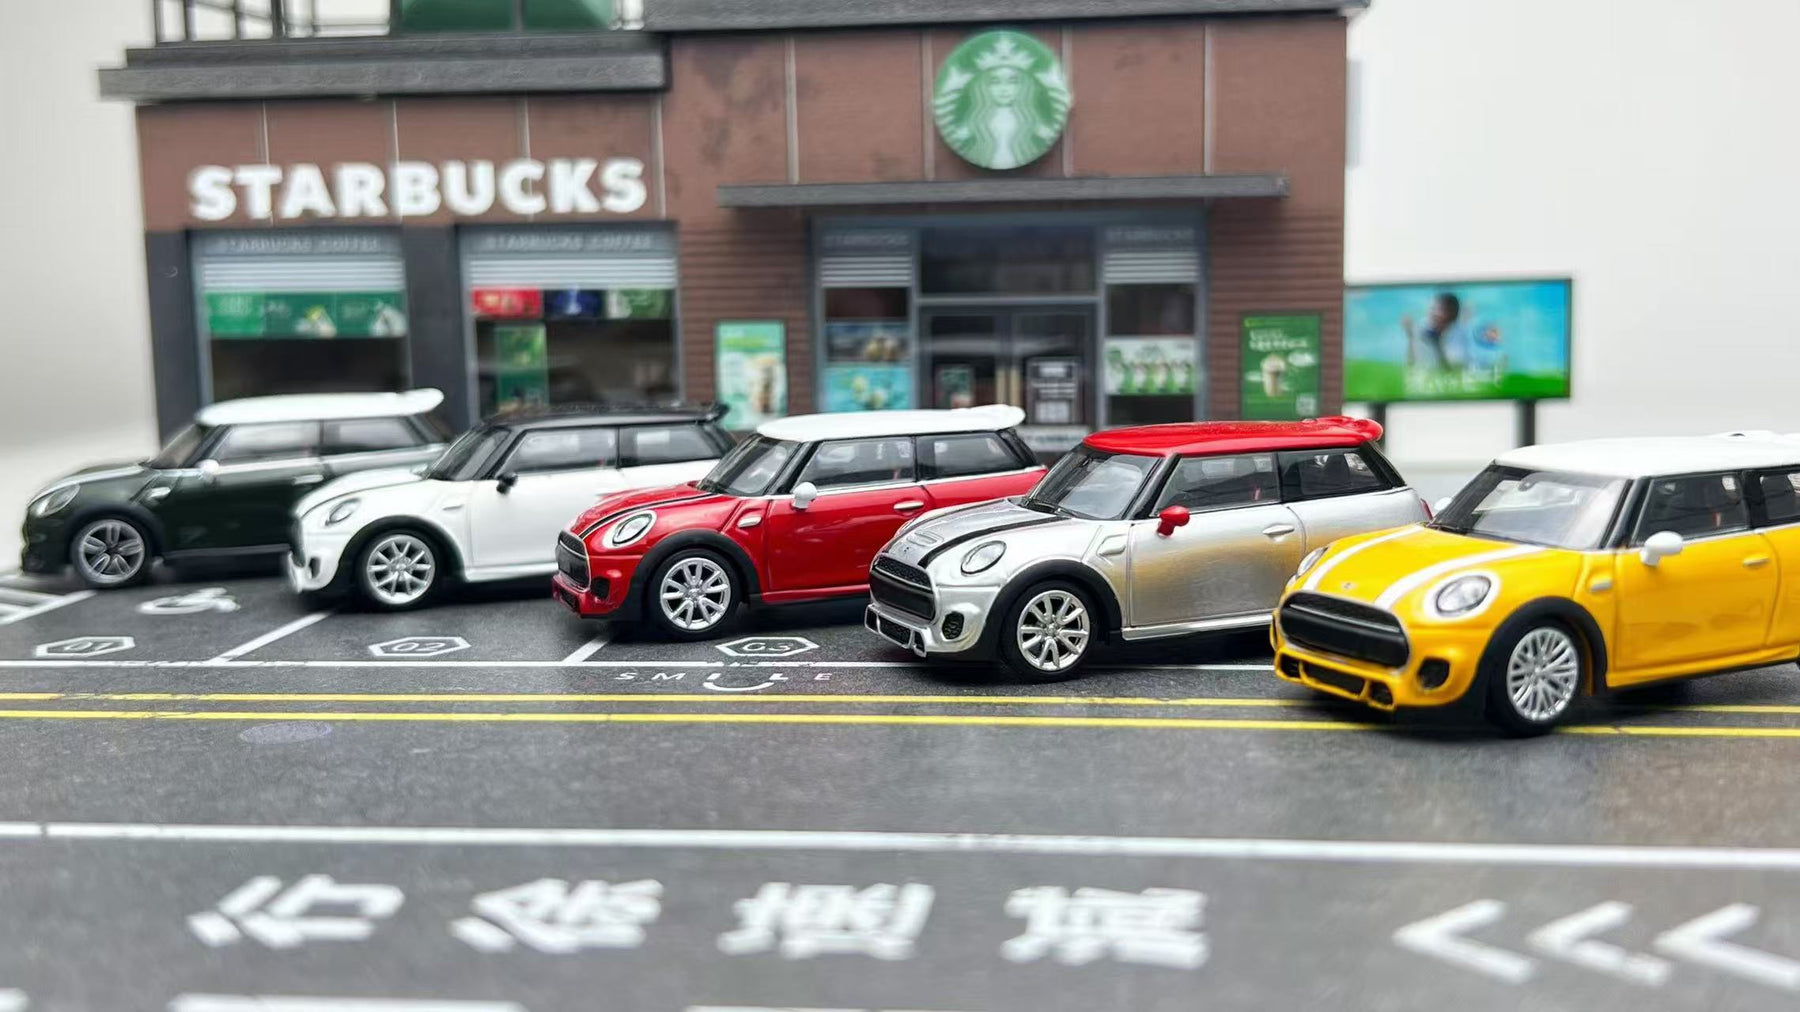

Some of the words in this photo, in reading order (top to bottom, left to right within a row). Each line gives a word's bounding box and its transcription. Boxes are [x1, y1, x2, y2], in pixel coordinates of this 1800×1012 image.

[189, 157, 648, 221] STARBUCKS
[391, 642, 446, 652] 02
[614, 672, 833, 682] SMILE
